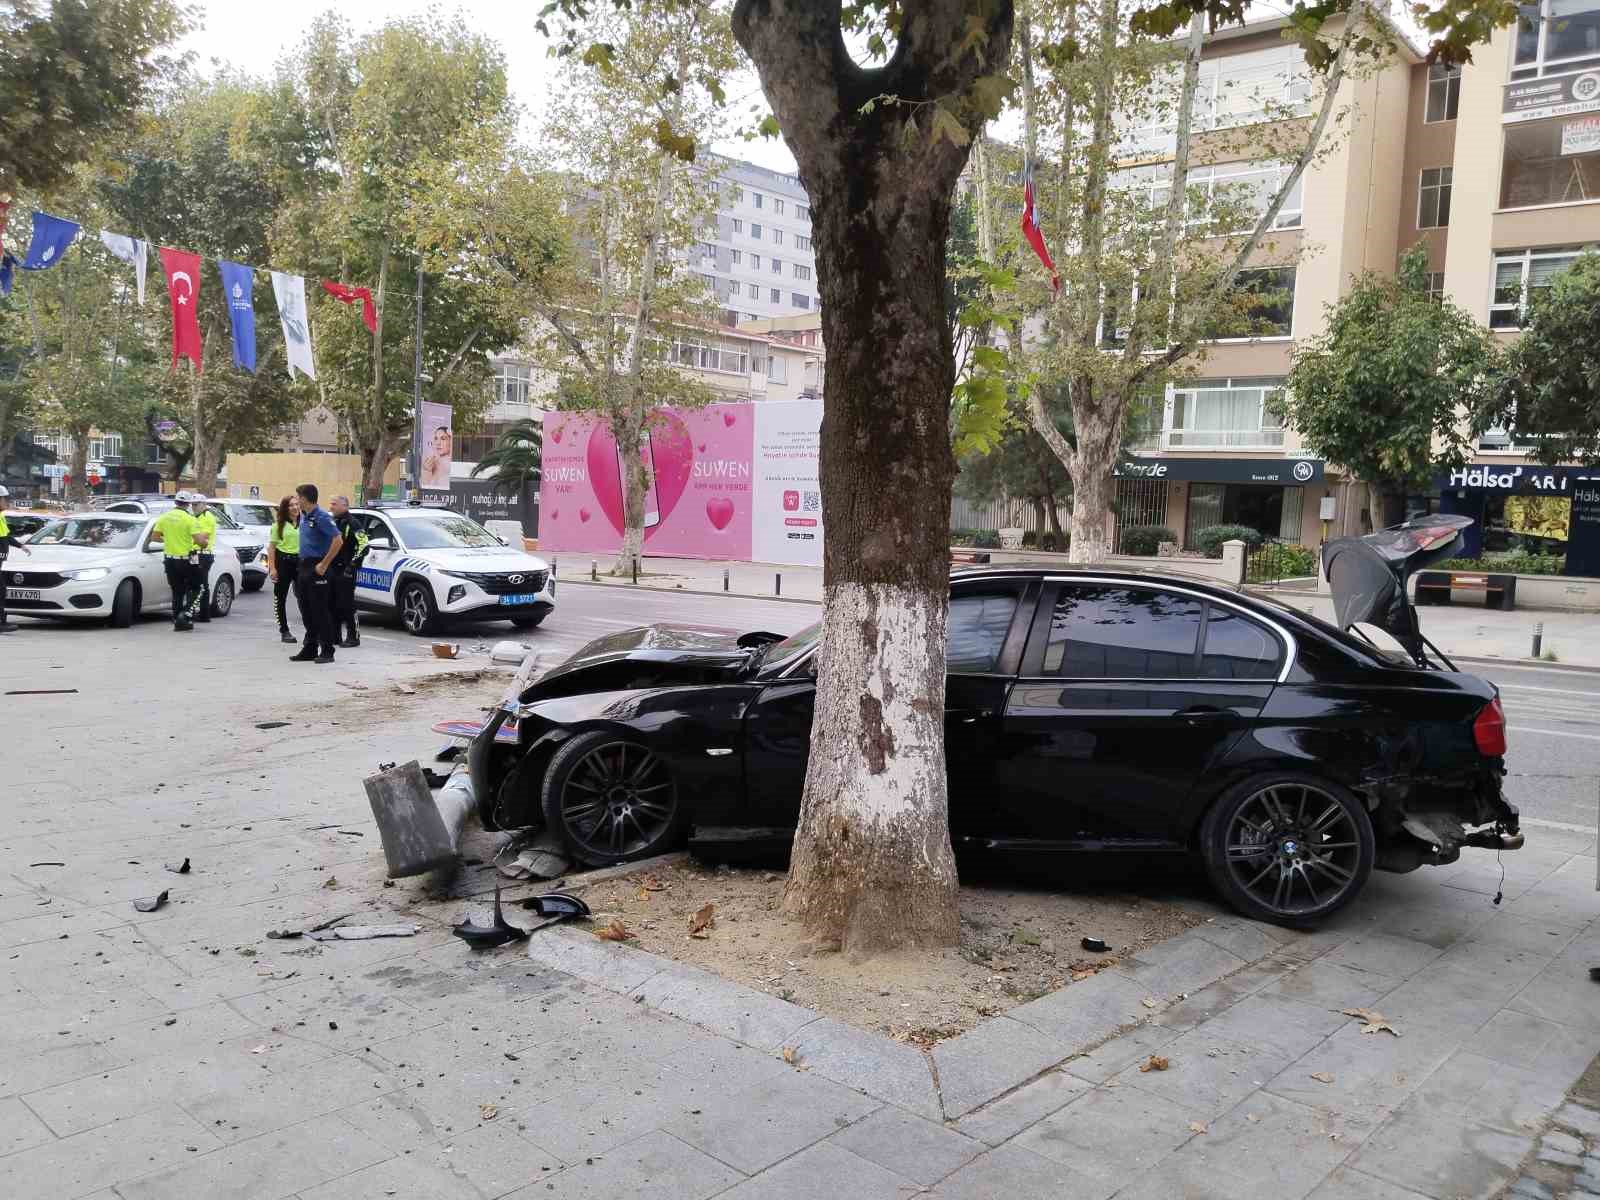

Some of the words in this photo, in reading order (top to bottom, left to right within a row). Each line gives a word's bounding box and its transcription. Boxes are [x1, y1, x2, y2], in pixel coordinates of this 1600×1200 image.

[544, 467, 585, 481] SUWEN
[694, 460, 750, 477] SUWEN
[1450, 466, 1514, 488] Hälsa
